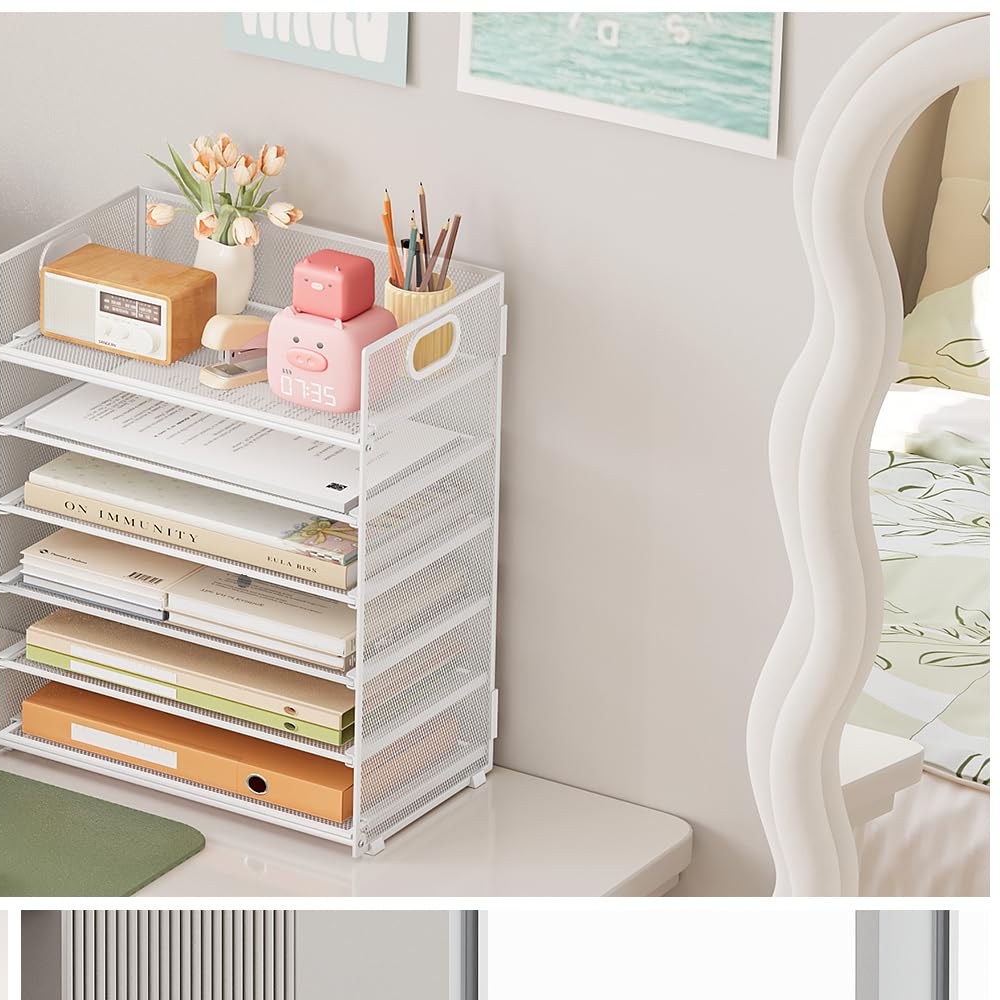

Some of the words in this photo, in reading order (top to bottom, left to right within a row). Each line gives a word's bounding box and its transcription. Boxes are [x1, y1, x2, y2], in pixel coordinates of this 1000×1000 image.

[280, 374, 336, 406] 07:35
[64, 500, 88, 514] ON
[98, 509, 200, 544] IMMUNITY
[266, 555, 294, 570] EULA
[296, 562, 318, 574] BISS
